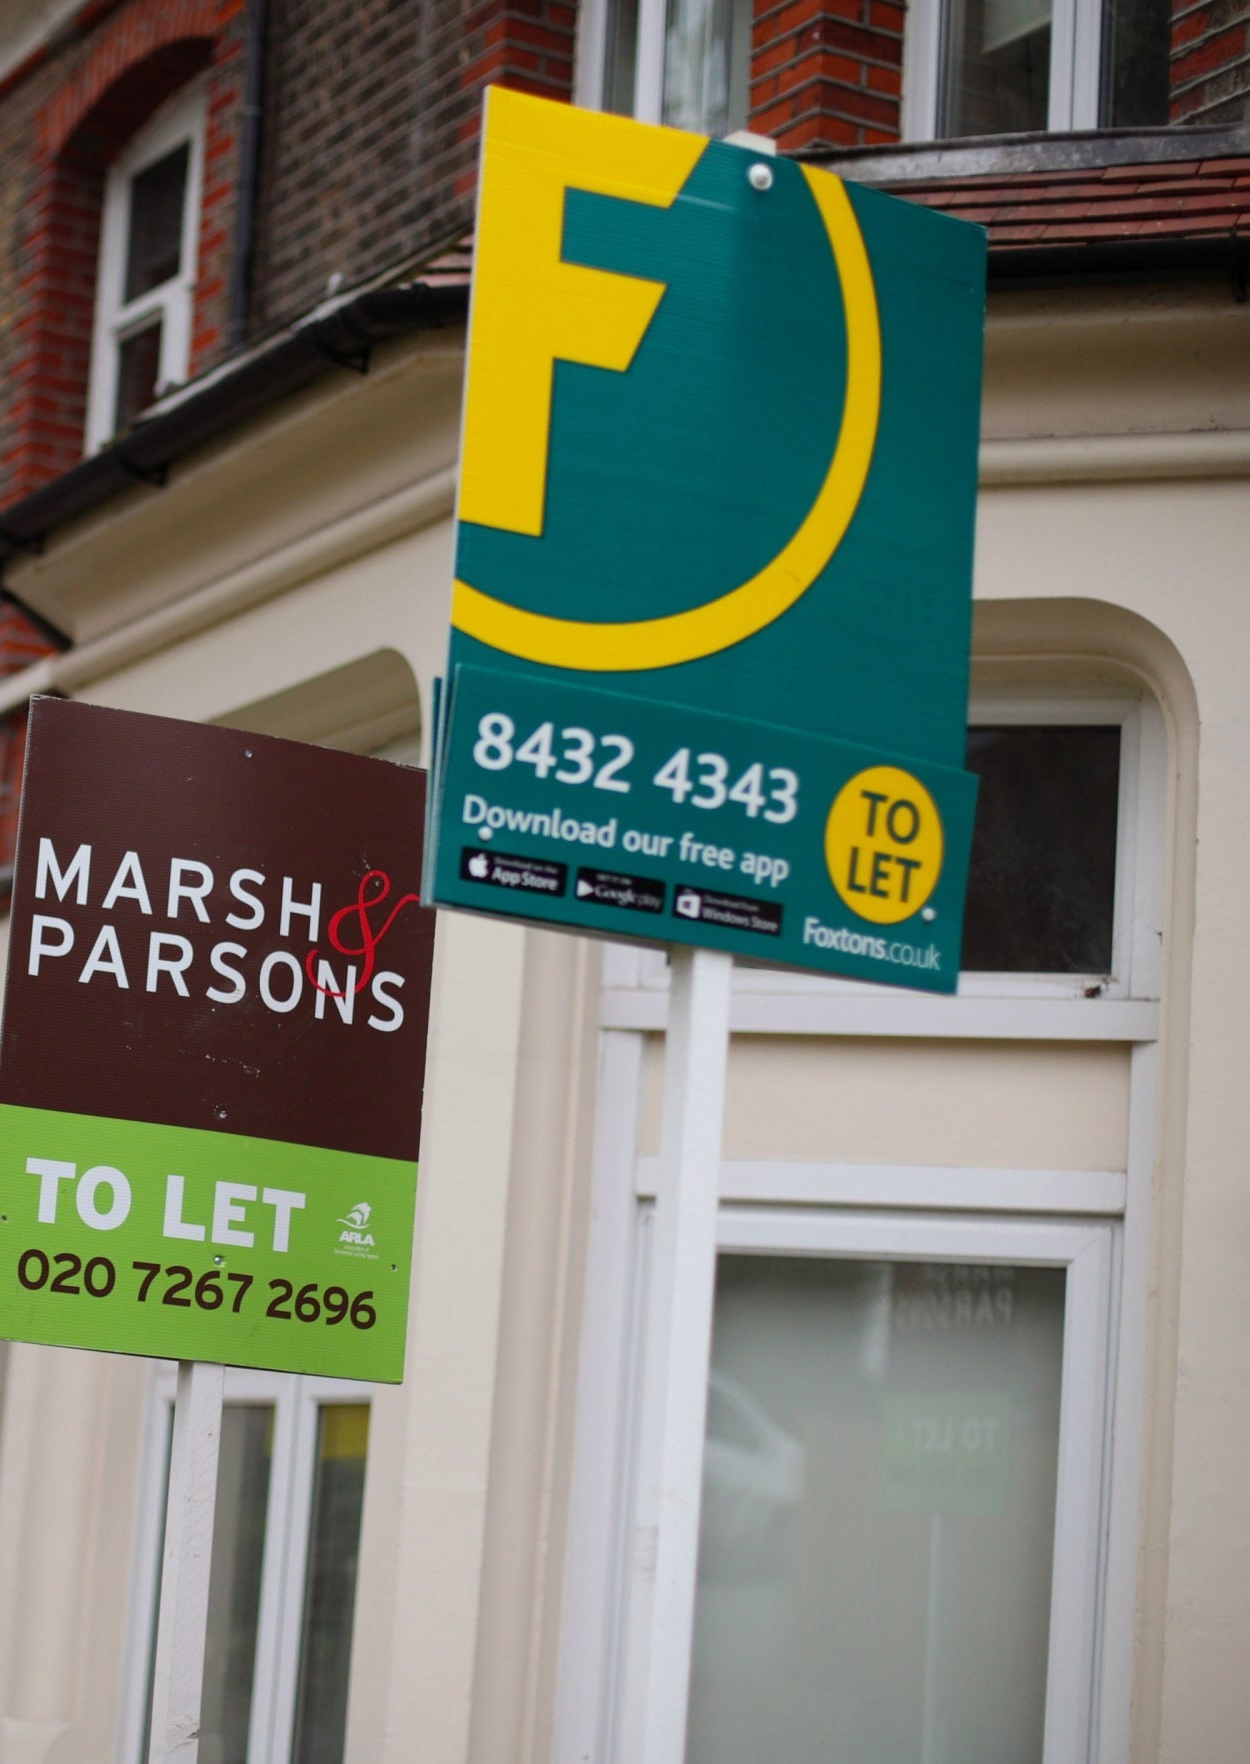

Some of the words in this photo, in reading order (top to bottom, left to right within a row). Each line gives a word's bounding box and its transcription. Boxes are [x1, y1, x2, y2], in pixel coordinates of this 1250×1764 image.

[472, 711, 635, 794] 8432
[654, 747, 799, 825] 4343
[462, 794, 617, 850] Download
[622, 821, 674, 858] our
[679, 831, 735, 871] free
[740, 851, 790, 887] app
[860, 789, 922, 846] TO
[35, 837, 322, 943] MARSH
[491, 866, 521, 887] App
[521, 870, 559, 892] Store
[847, 846, 923, 904] LET
[703, 906, 750, 928] Windows
[751, 915, 778, 933] Store
[804, 916, 941, 971] Foxtons.co.uk
[27, 914, 407, 1032] PARSONS
[26, 1157, 132, 1231] TO
[163, 1174, 306, 1253] LET
[338, 1230, 375, 1246] ARLA
[17, 1248, 116, 1298] 020
[132, 1261, 253, 1314] 7267
[266, 1279, 377, 1330] 2696
